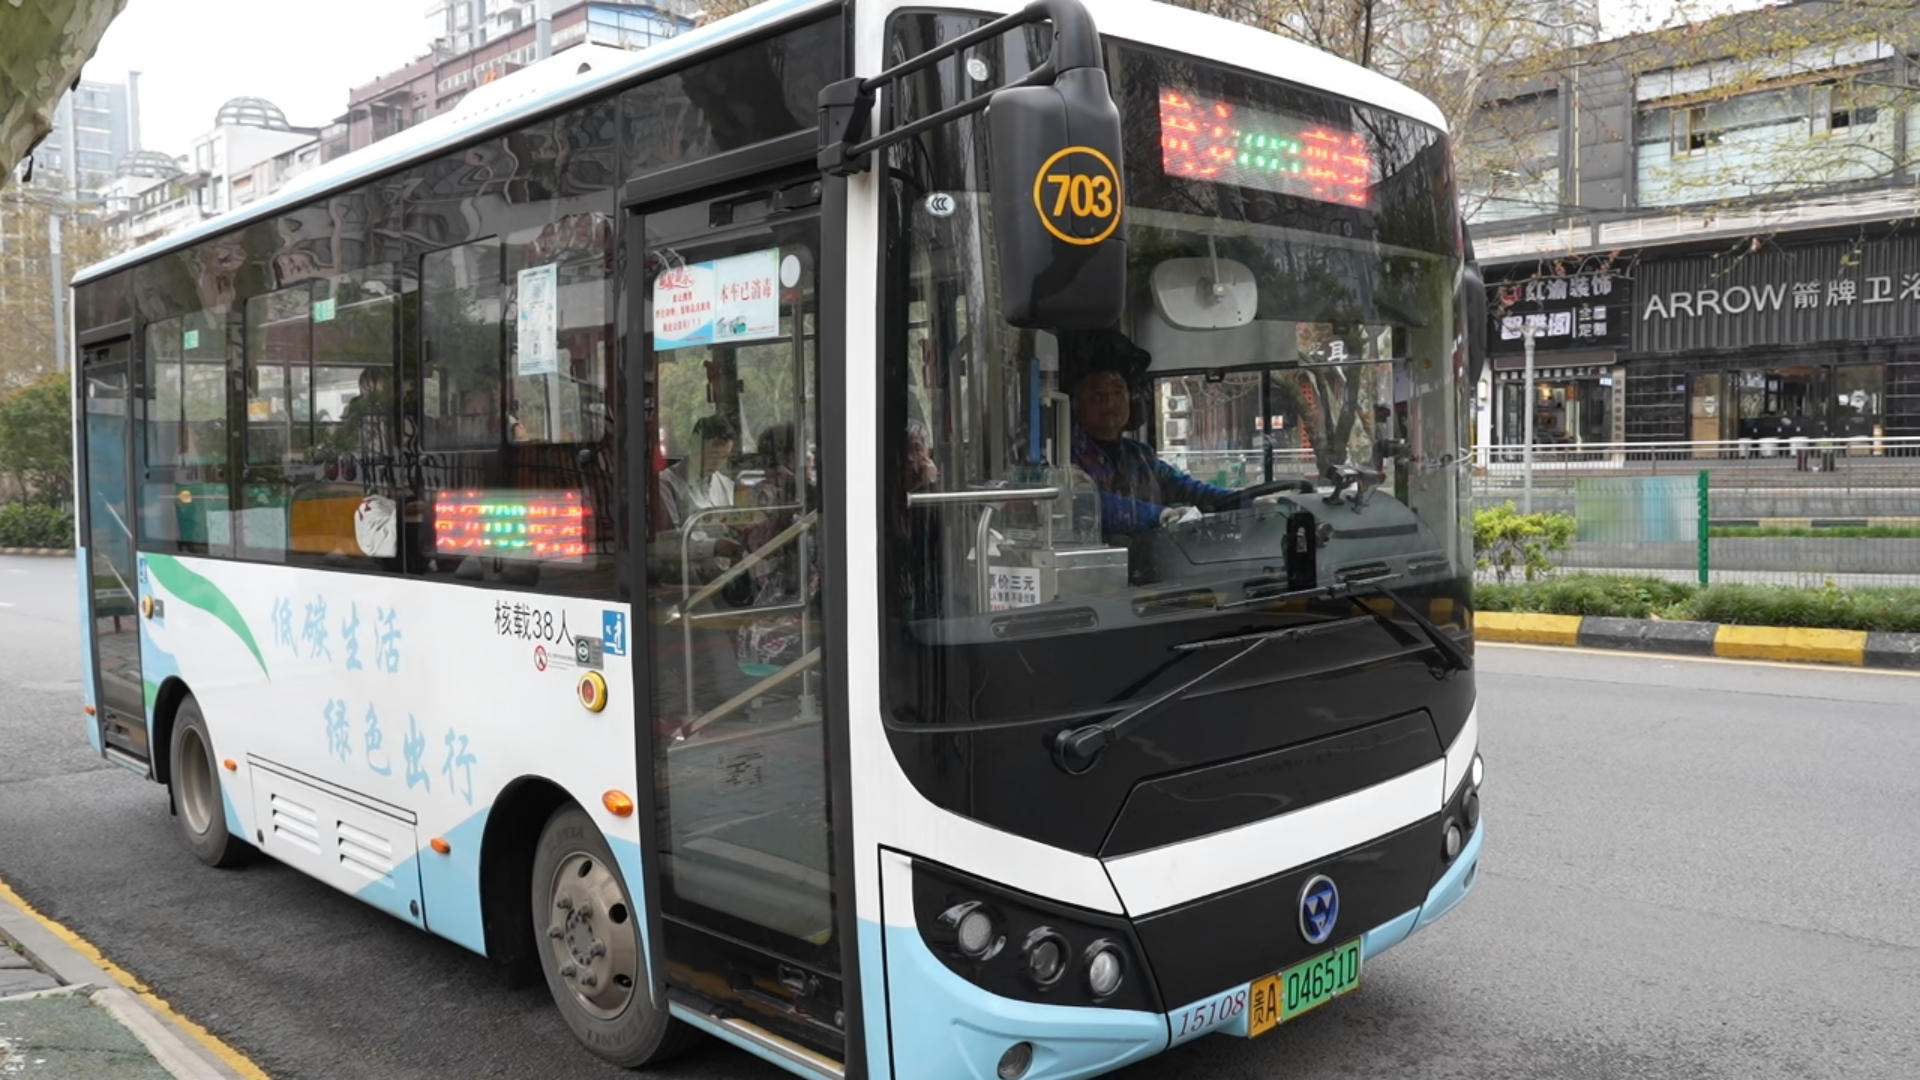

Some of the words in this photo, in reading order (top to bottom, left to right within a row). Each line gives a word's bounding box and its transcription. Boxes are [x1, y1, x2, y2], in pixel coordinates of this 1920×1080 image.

[1047, 174, 1113, 217] 703
[721, 277, 772, 304] 本车已消毒
[1643, 283, 1787, 320] ARROW
[1793, 273, 1920, 308] 箭牌卫浴
[271, 594, 402, 673] 低碳生活
[494, 600, 574, 648] 核载38人
[324, 698, 477, 806] 绿色出行
[1253, 982, 1278, 1028] 贵A
[1287, 946, 1359, 1011] 04651D
[1178, 990, 1246, 1038] 15108
